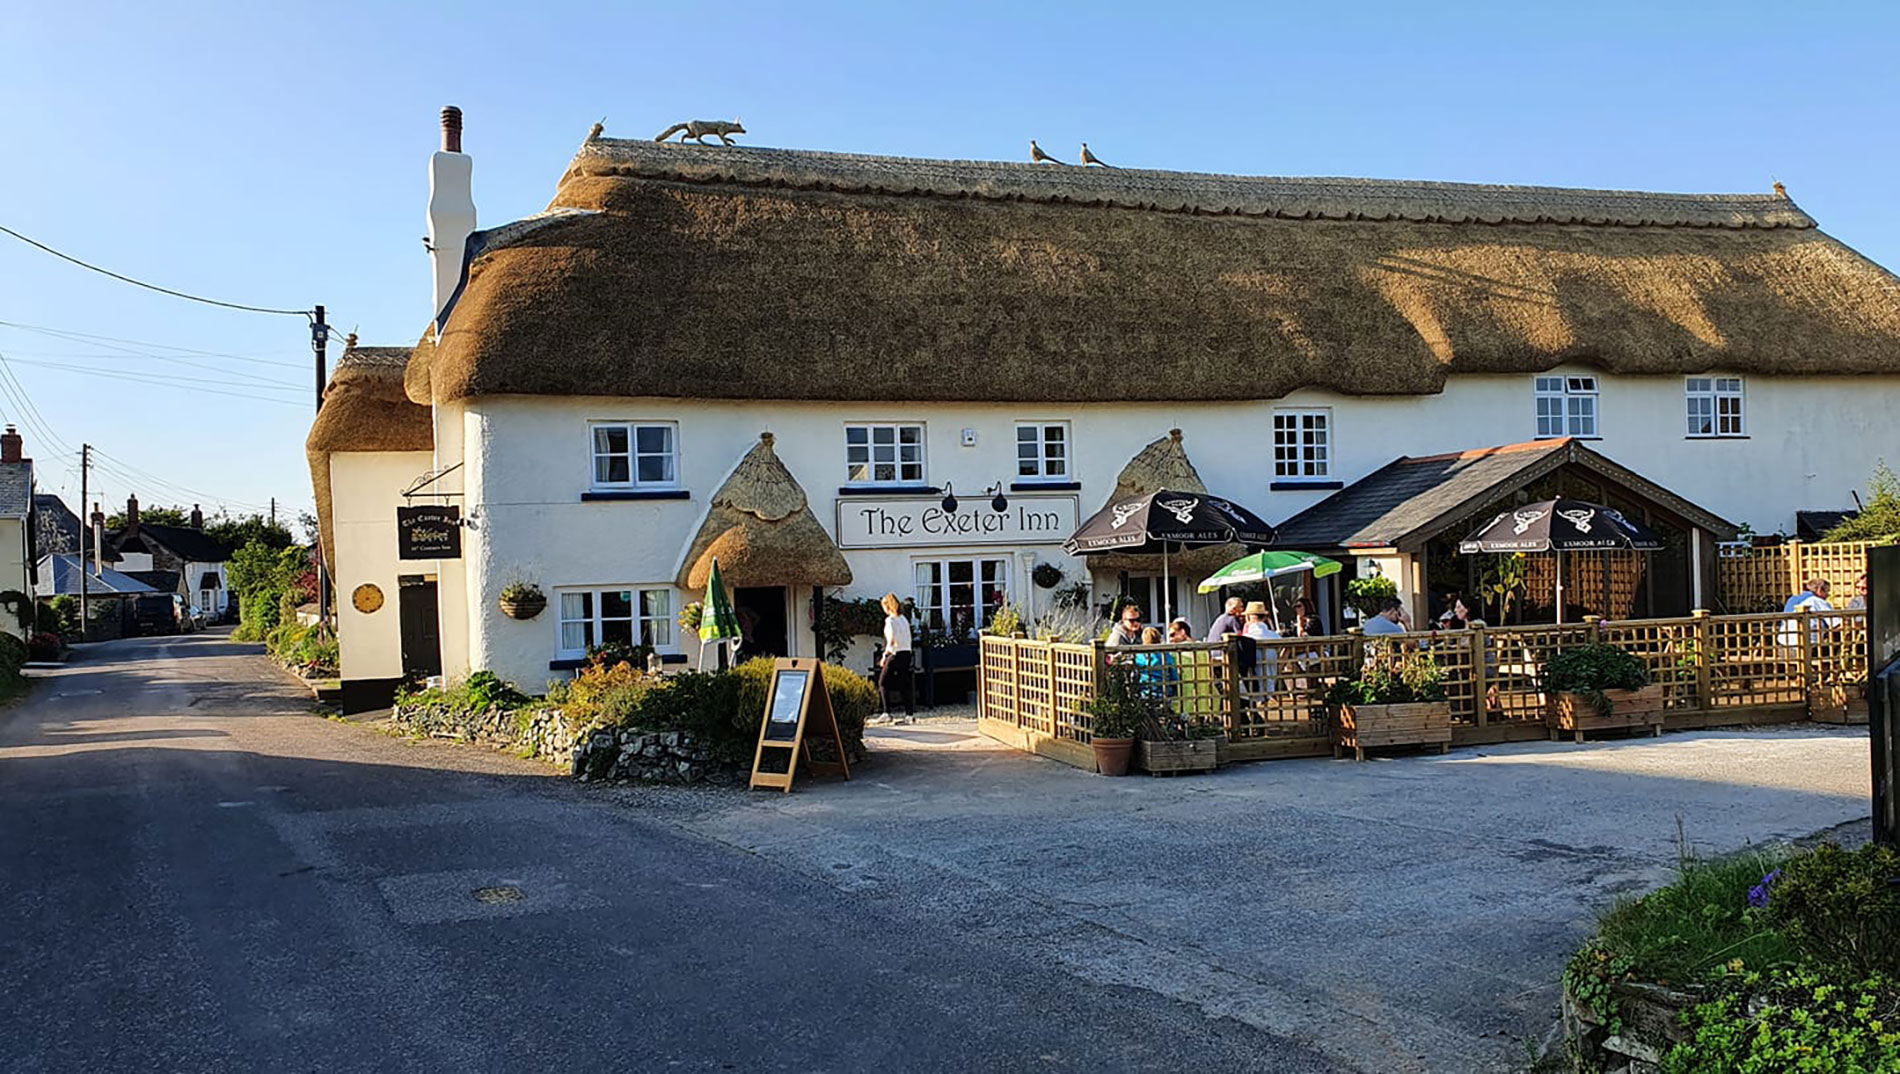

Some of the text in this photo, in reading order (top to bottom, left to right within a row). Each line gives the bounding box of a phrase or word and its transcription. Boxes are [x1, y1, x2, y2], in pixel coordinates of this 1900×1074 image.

[860, 506, 1060, 537] The Exeter Inn
[1119, 535, 1136, 543] ALES
[1197, 532, 1218, 540] ALES
[1520, 541, 1537, 549] ALES
